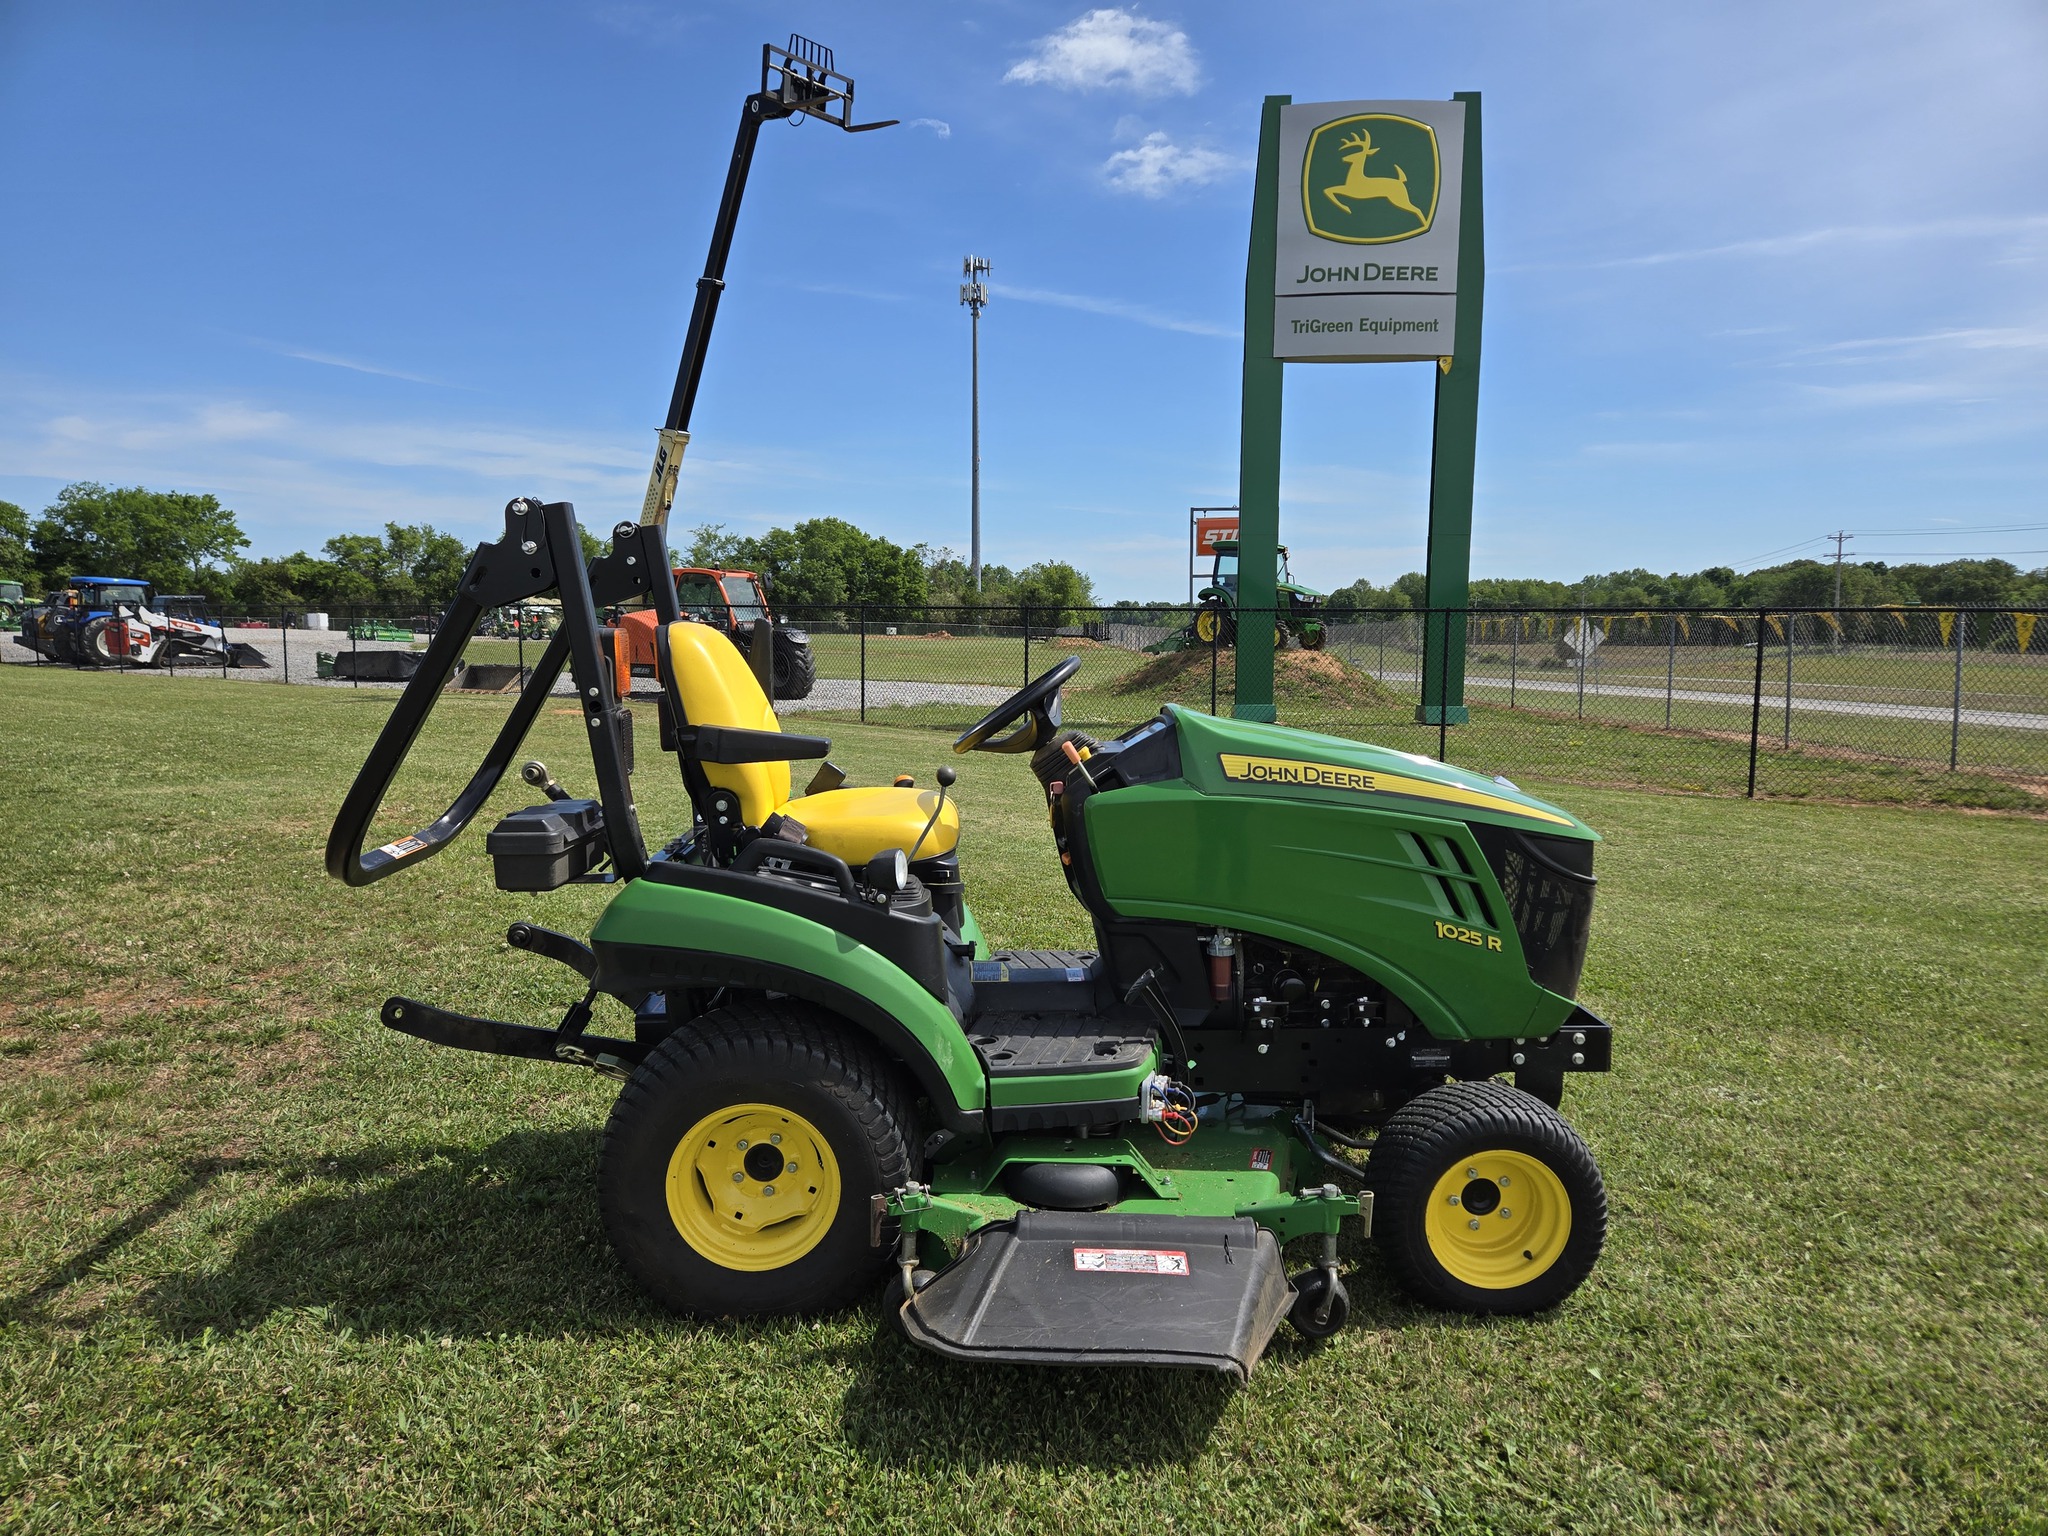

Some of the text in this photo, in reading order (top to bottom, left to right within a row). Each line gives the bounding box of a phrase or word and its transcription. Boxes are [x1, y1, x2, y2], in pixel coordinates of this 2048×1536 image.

[1296, 263, 1439, 284] JOHN DEERE
[1290, 317, 1440, 335] TriGreen Equipment
[655, 445, 668, 484] JLG
[1201, 528, 1240, 545] STI
[1239, 762, 1376, 789] JOHN DEERE
[1434, 920, 1503, 953] 1025 R
